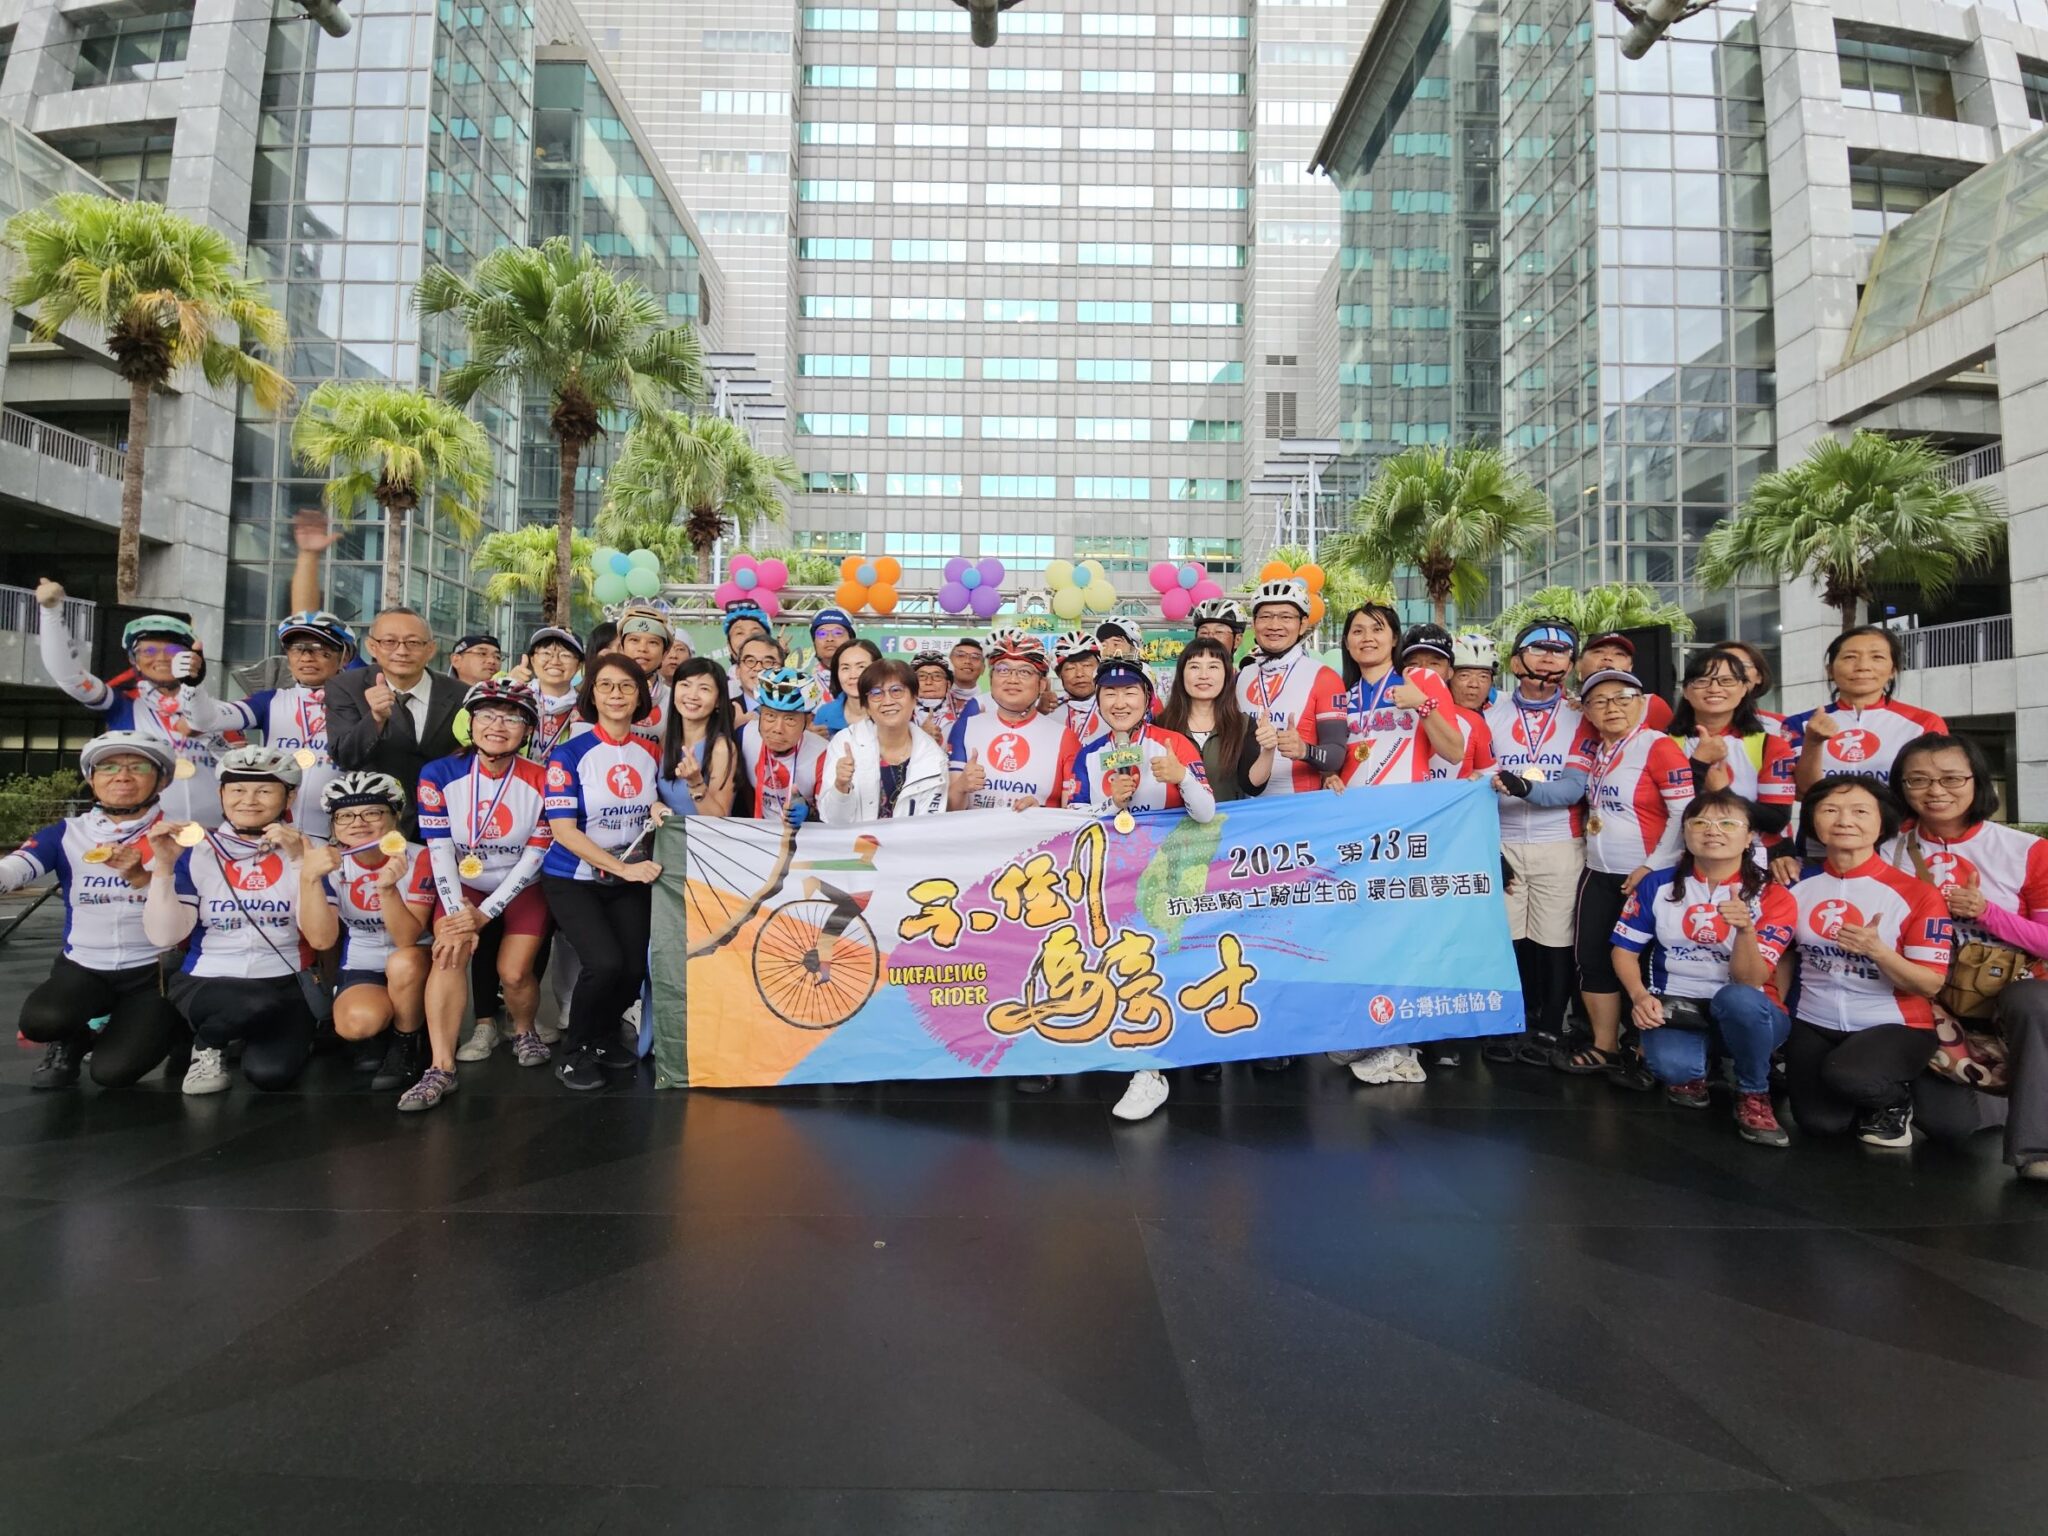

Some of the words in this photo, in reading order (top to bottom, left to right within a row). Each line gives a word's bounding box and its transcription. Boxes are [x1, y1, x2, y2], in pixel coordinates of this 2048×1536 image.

[985, 778, 1037, 794] AIWAN
[1229, 841, 1316, 878] 2025
[1337, 829, 1428, 863] 第13屆
[1167, 880, 1357, 916] 抗癌騎士騎出生命
[1367, 873, 1491, 901] 環台圓夢活動
[930, 985, 989, 1007] RIDER
[1398, 991, 1503, 1020] 台灣抗癌協會
